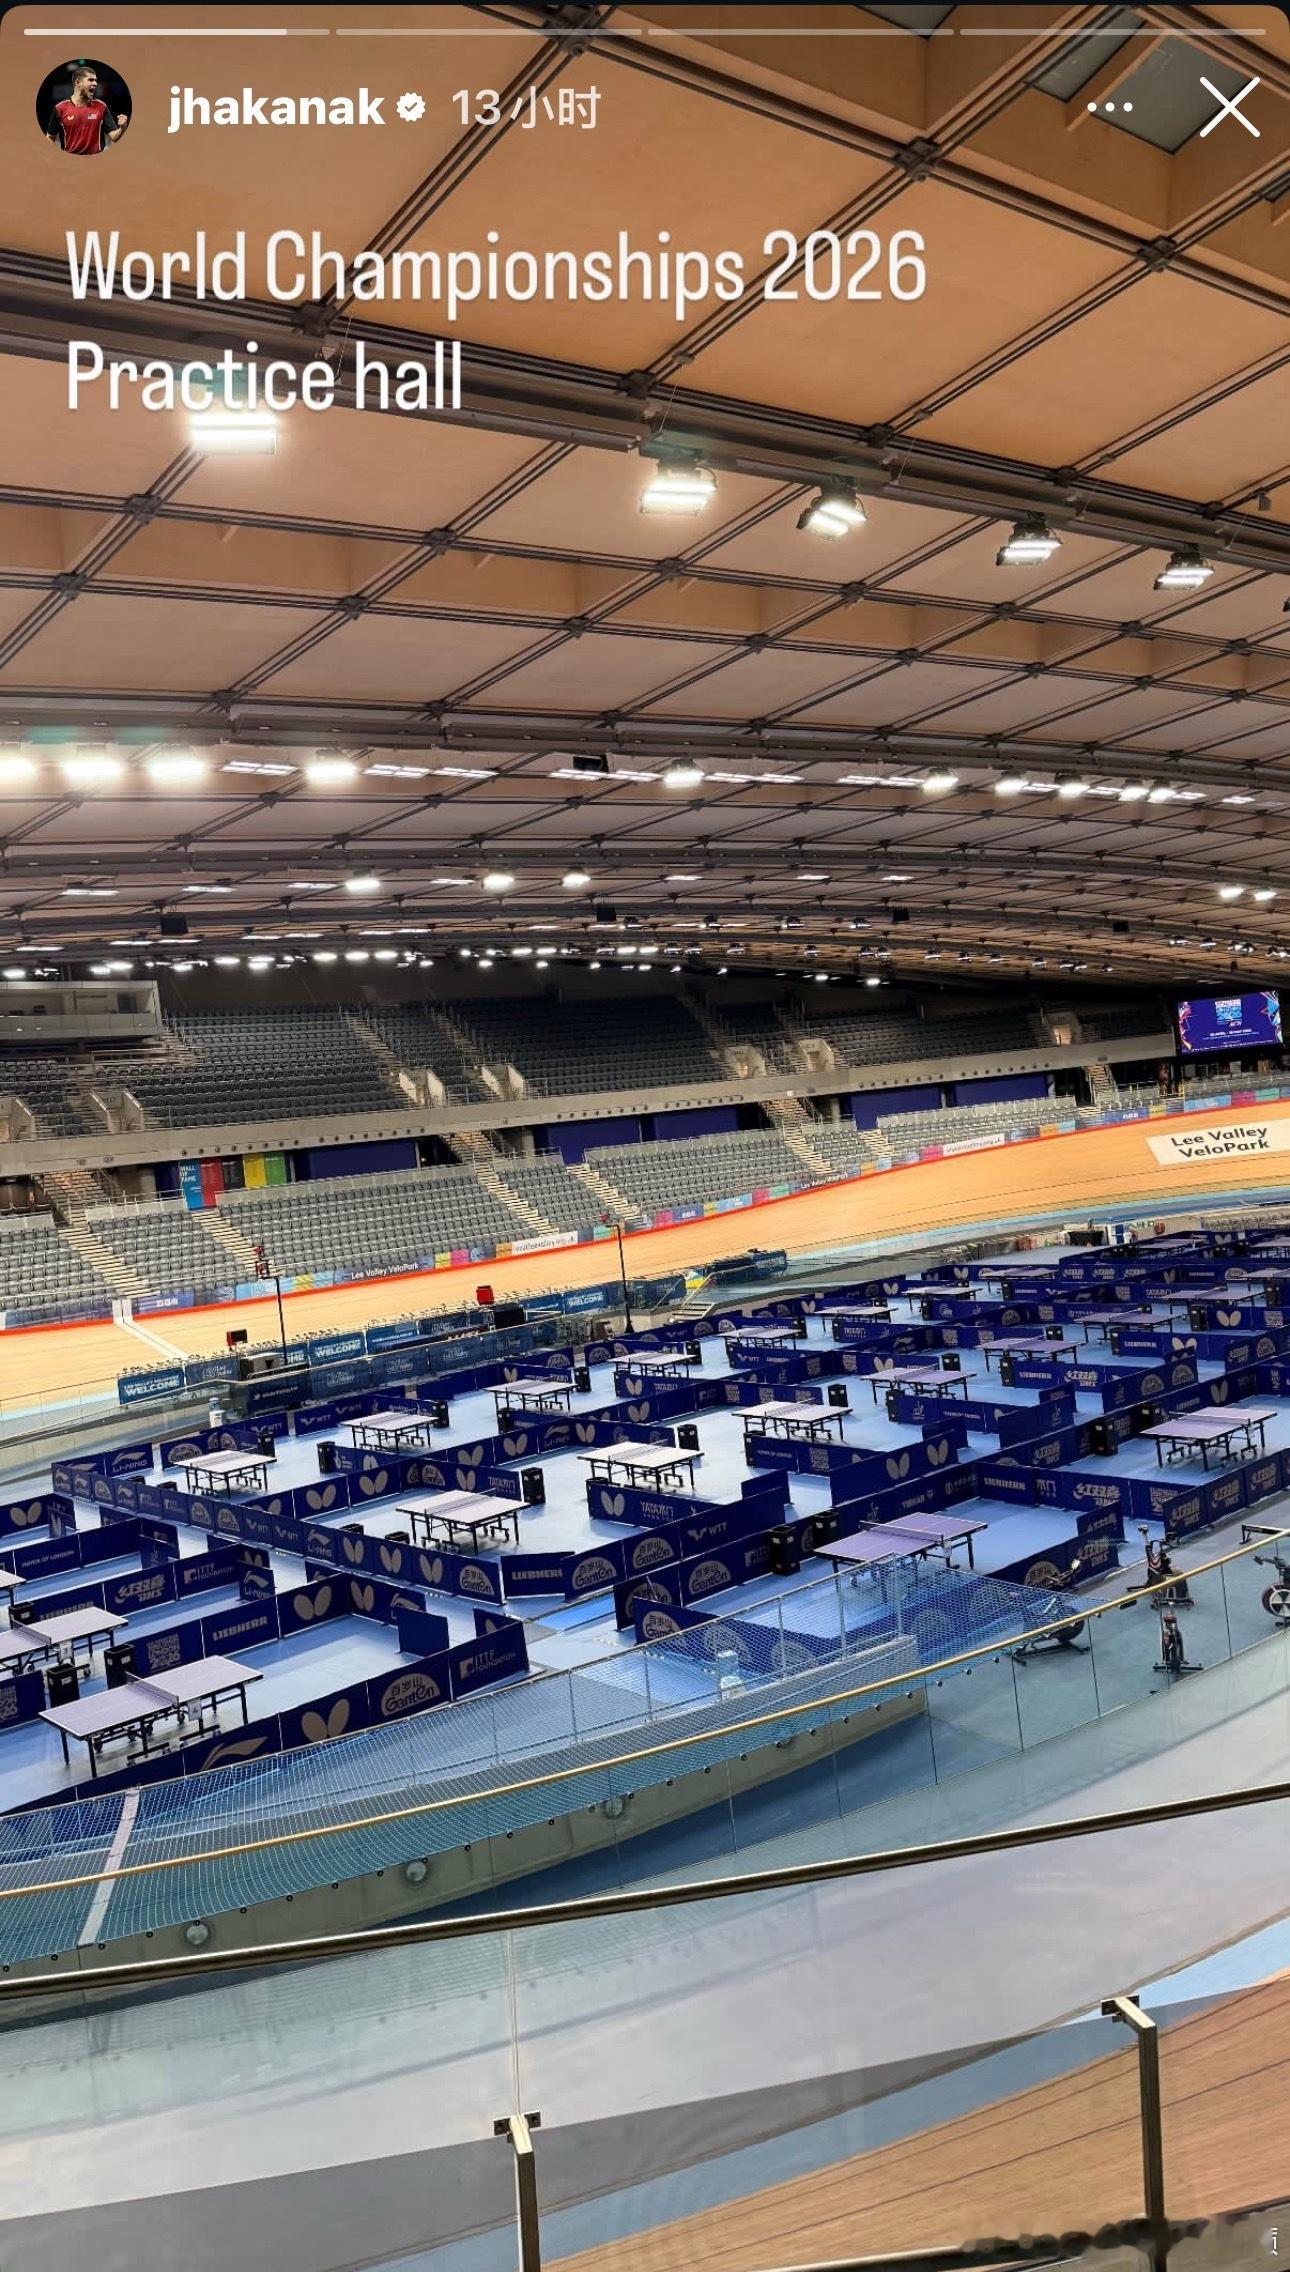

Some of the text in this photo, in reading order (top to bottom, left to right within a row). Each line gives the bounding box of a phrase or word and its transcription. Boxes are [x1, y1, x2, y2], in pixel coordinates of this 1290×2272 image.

[1171, 1127, 1268, 1147] Lee Valley
[1178, 1139, 1270, 1158] VeloPark
[351, 1262, 419, 1280] Lee Valley VeloPark
[315, 1339, 361, 1358] WELCOME
[125, 1379, 180, 1396] WELCOME
[315, 1414, 331, 1424] WTT
[112, 1460, 148, 1474] LI-NING
[984, 1477, 1026, 1491] LIEBHERR
[709, 1523, 728, 1534] WTT
[636, 1548, 670, 1565] Ganten
[461, 1576, 492, 1593] Ganten
[575, 1567, 613, 1587] Ganten
[692, 1571, 728, 1592] Ganten
[138, 1589, 163, 1603] DHS
[212, 1616, 268, 1642] LIEBHERR
[473, 1650, 495, 1667] ITTF
[473, 1652, 517, 1674] FOUNDATION
[391, 1674, 424, 1697] 百岁山
[385, 1686, 435, 1712] Ganten
